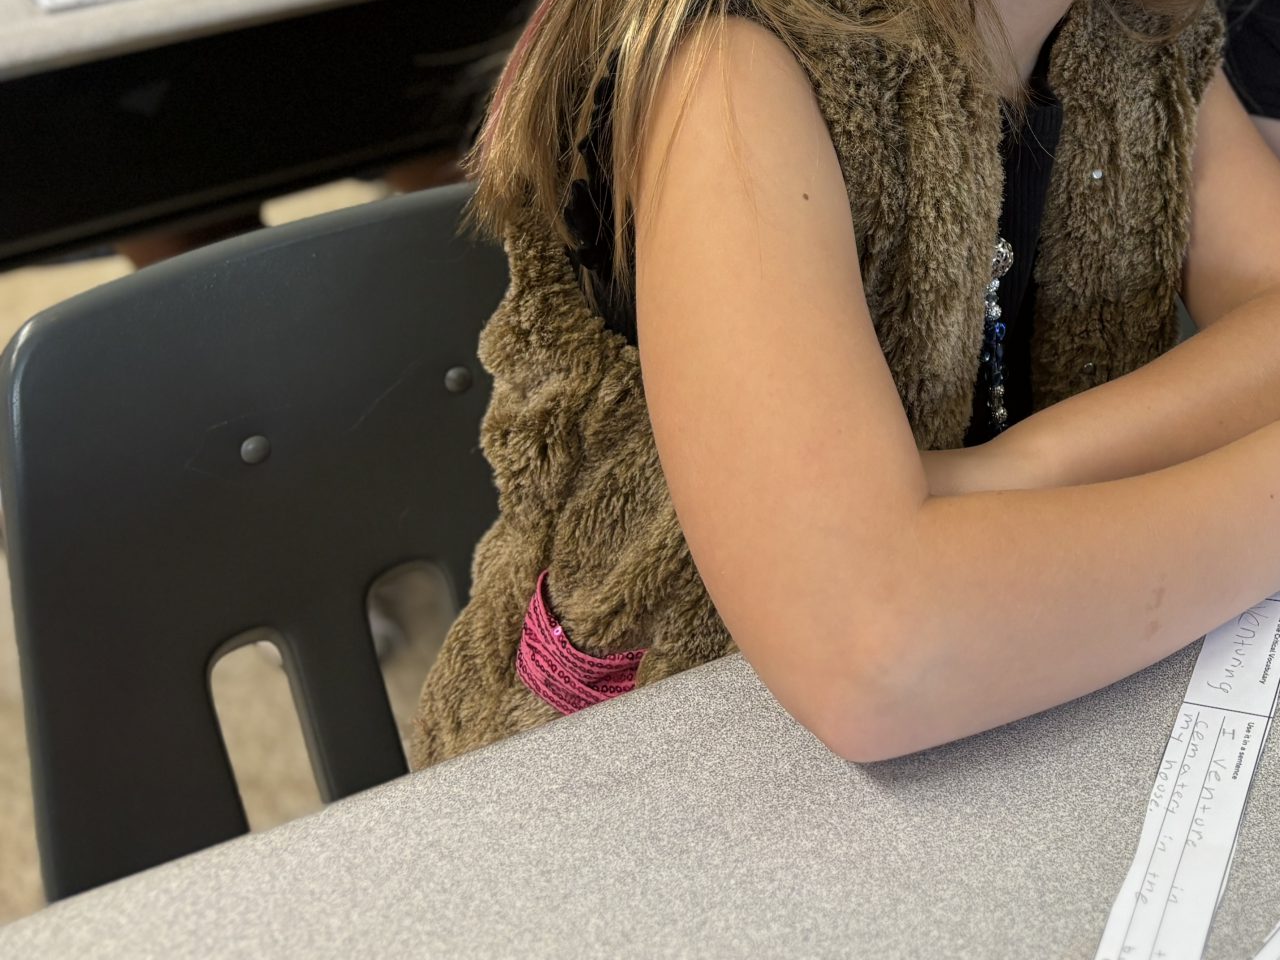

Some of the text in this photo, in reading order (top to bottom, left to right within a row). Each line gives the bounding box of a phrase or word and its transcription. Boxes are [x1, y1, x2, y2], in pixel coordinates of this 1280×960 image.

[1270, 633, 1280, 653] Critical
[1259, 652, 1275, 685] Vocabulary
[1170, 713, 1193, 742] my
[1223, 728, 1236, 740] I
[1247, 722, 1255, 734] Use
[1231, 751, 1245, 780] sentence
[1168, 885, 1184, 904] in
